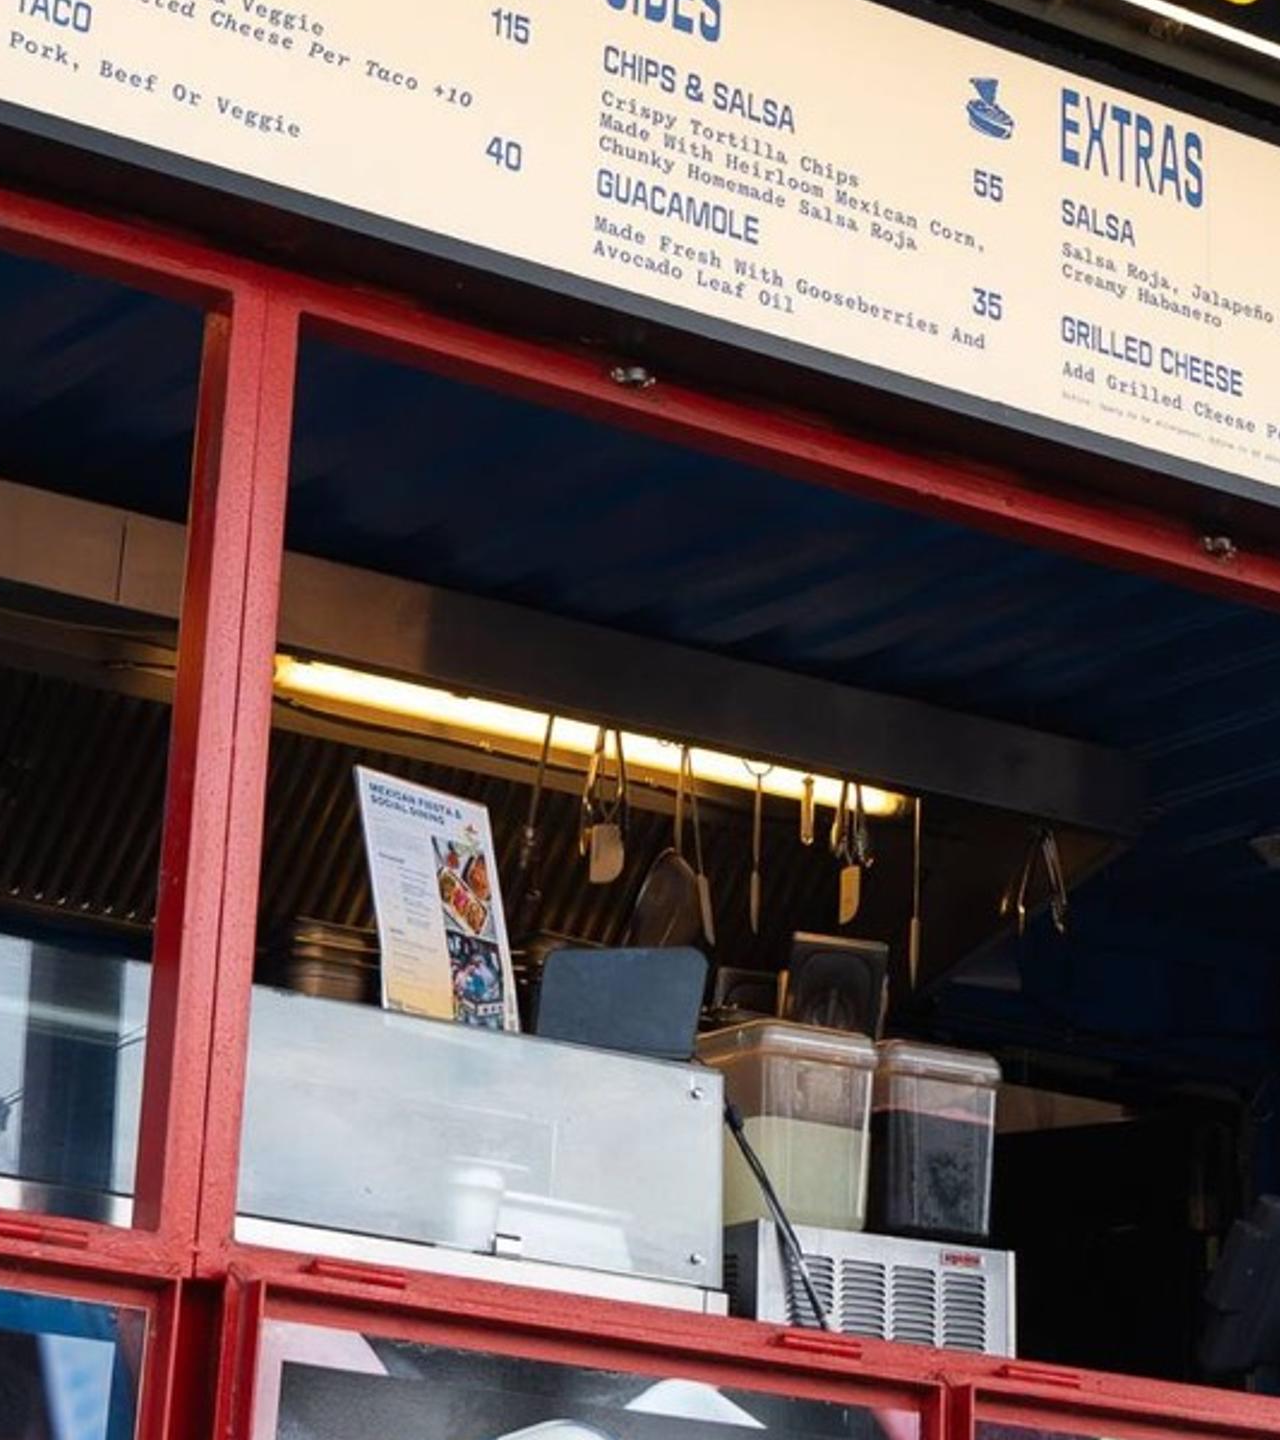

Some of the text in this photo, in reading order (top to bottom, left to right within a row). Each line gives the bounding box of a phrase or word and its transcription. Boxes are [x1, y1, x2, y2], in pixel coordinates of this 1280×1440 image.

[209, 9, 294, 50] Cheese
[308, 41, 351, 67] Per
[365, 59, 419, 91] Taco
[491, 7, 531, 45] 115
[9, 30, 301, 138] Pork, Beef Or Veggie
[603, 45, 796, 135] CHIPS & SALSA
[485, 136, 522, 172] 40
[601, 89, 860, 188] Crispy Tortilla Chips
[1060, 87, 1203, 209] EXTRAS
[596, 168, 760, 246] GUACAMOLE
[598, 134, 918, 251] Chunky Homemade Salsa Roja
[599, 111, 984, 253] Made With Heirloom Mexican Corn,
[973, 168, 1004, 203] 55
[1061, 198, 1136, 247] SALSA
[592, 239, 794, 314] Avocado Leaf Oil
[594, 214, 985, 350] Made Fresh With Gooseberries And
[972, 287, 1002, 321] 35
[1061, 241, 1117, 273] Salsa
[1127, 262, 1179, 295] Roja,
[1191, 283, 1274, 324] Jalapeño
[1061, 262, 1223, 328] Creamy Habanero
[1061, 315, 1243, 398] GRILLED CHEESE
[1062, 360, 1096, 385] Add
[1105, 373, 1183, 411] Grilled
[1193, 400, 1256, 434] Cheese
